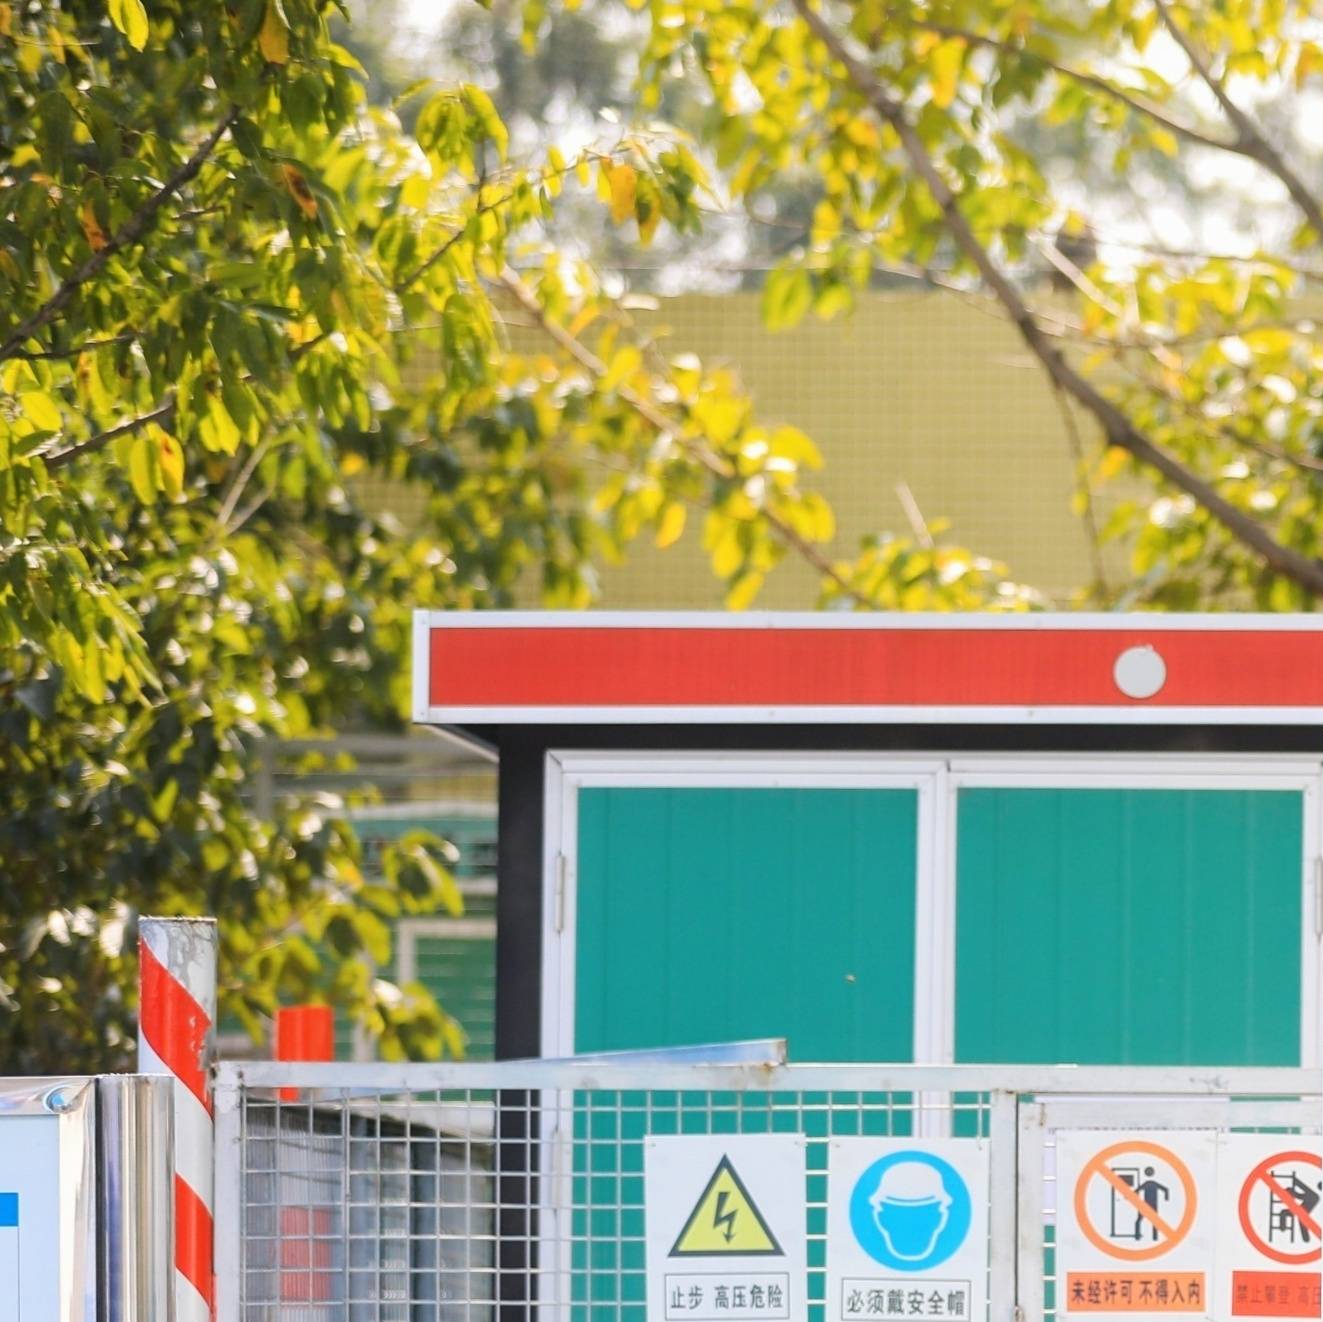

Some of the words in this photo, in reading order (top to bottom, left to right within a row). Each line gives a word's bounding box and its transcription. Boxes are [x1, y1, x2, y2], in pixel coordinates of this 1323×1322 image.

[670, 1285, 704, 1310] 止步
[714, 1284, 783, 1309] 高压危险
[847, 1289, 966, 1316] 必须戴安全帽
[1072, 1280, 1133, 1304] 未经许可
[1139, 1279, 1200, 1305] 不得入内
